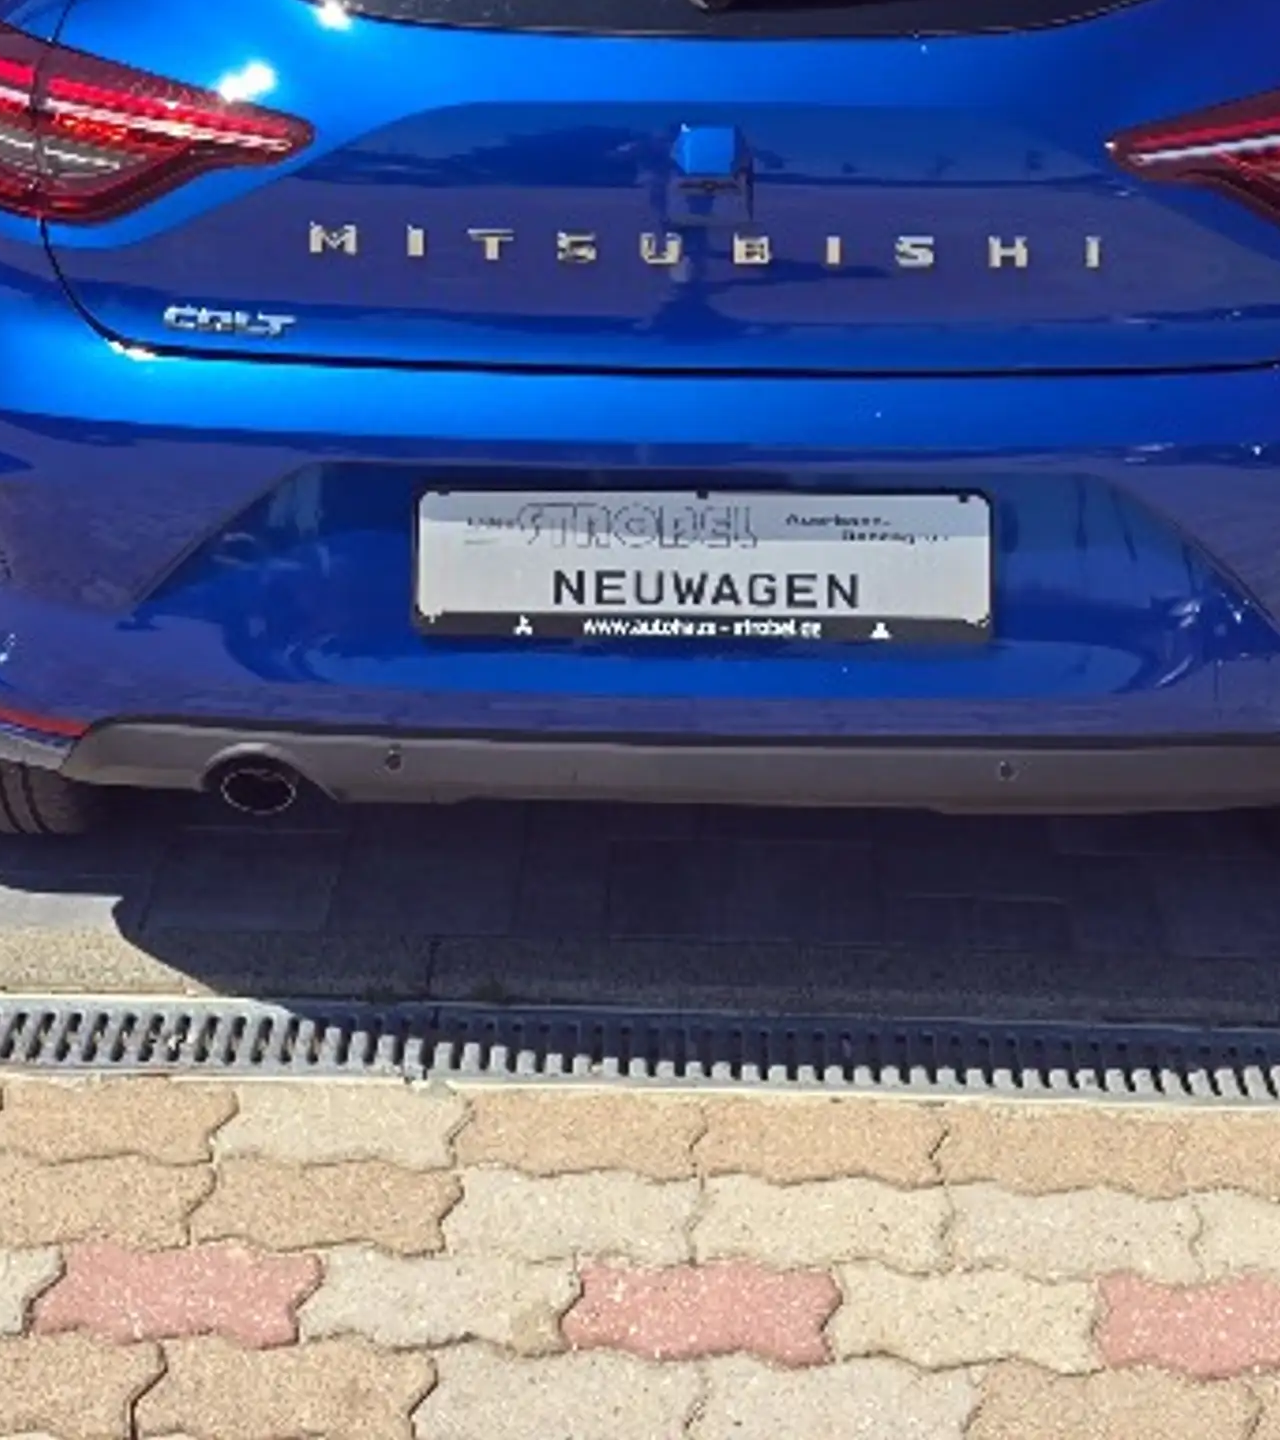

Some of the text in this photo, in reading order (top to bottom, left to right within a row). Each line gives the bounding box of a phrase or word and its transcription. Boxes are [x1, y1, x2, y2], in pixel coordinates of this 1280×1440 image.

[308, 221, 1102, 269] MITSUBISHI
[163, 304, 297, 336] COLT
[516, 502, 758, 548] STROBEL
[552, 569, 860, 609] NEUWAGEN
